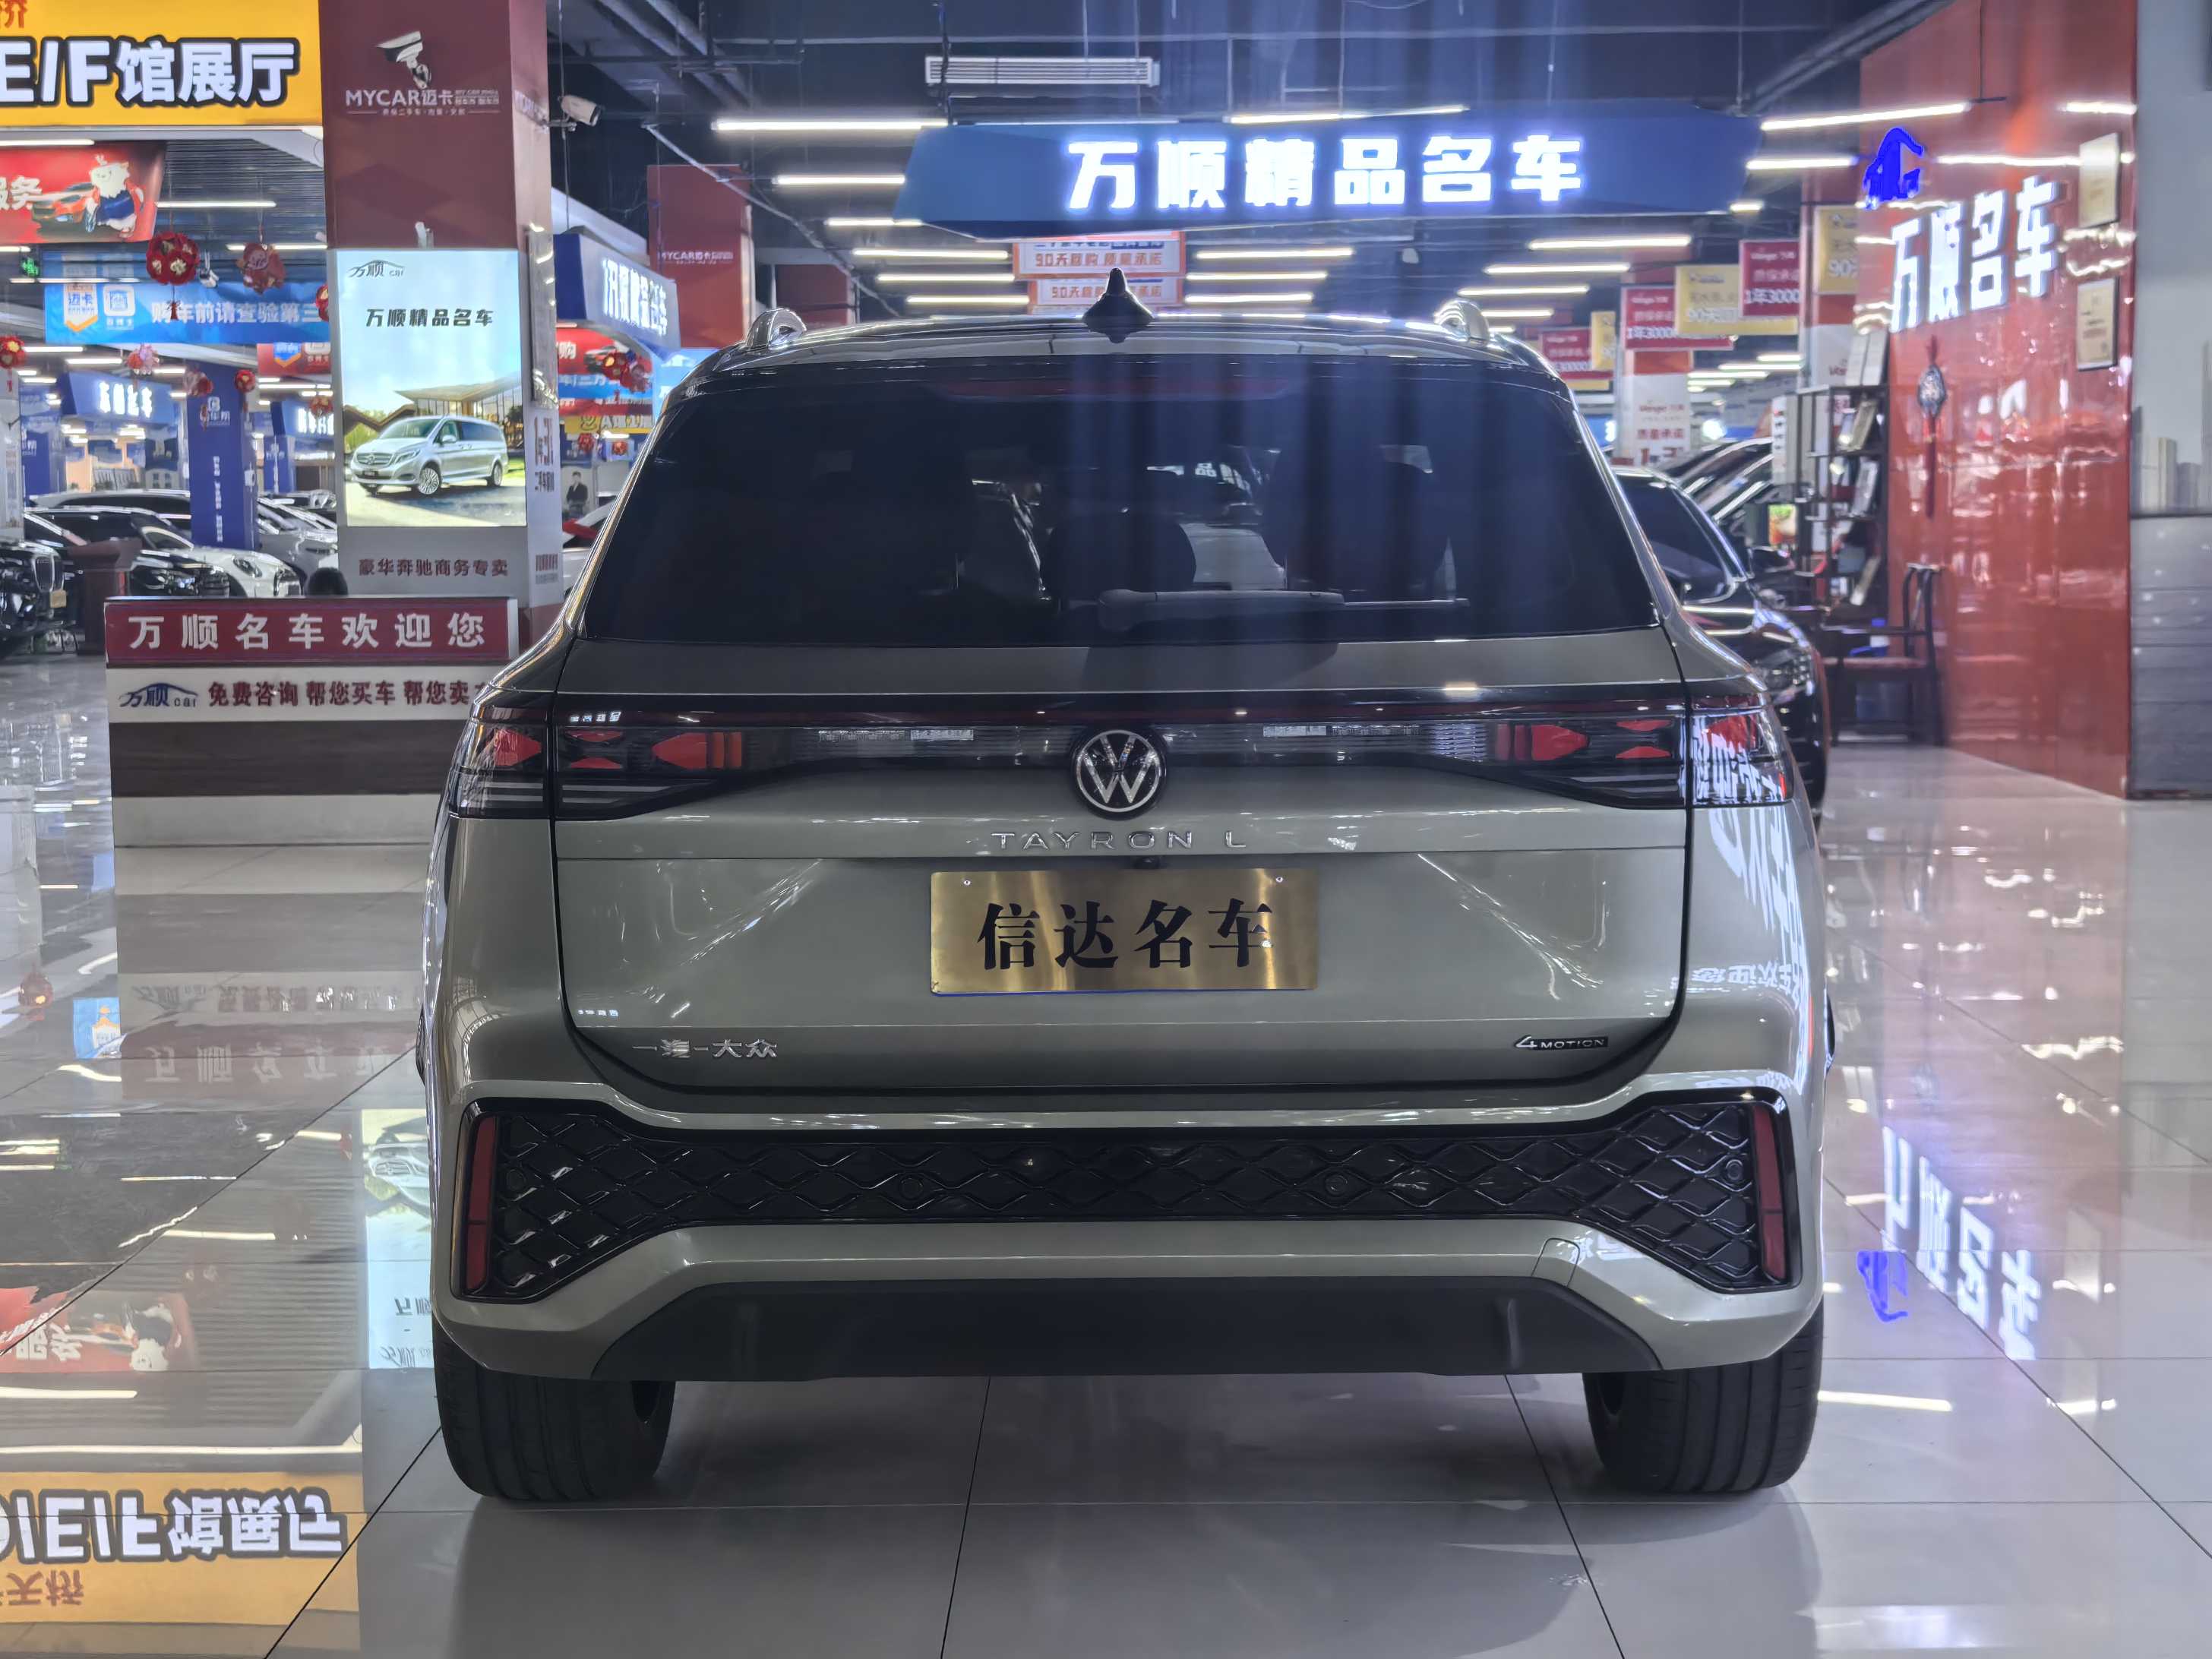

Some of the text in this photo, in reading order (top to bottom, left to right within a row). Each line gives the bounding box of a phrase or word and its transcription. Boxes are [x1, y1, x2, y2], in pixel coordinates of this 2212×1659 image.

[1067, 134, 1584, 211] 万顺精品名车
[365, 307, 495, 328] 万顺精品名车
[358, 558, 509, 576] 豪华奔驰商务专卖
[128, 611, 485, 650] 万顺名车欢迎您
[207, 681, 299, 707] 免费咨询
[305, 681, 396, 706] 帮您买车
[991, 830, 1247, 850] TAYRON L
[977, 897, 1275, 970] 信达名车
[1515, 1035, 1605, 1050] 4MOTION
